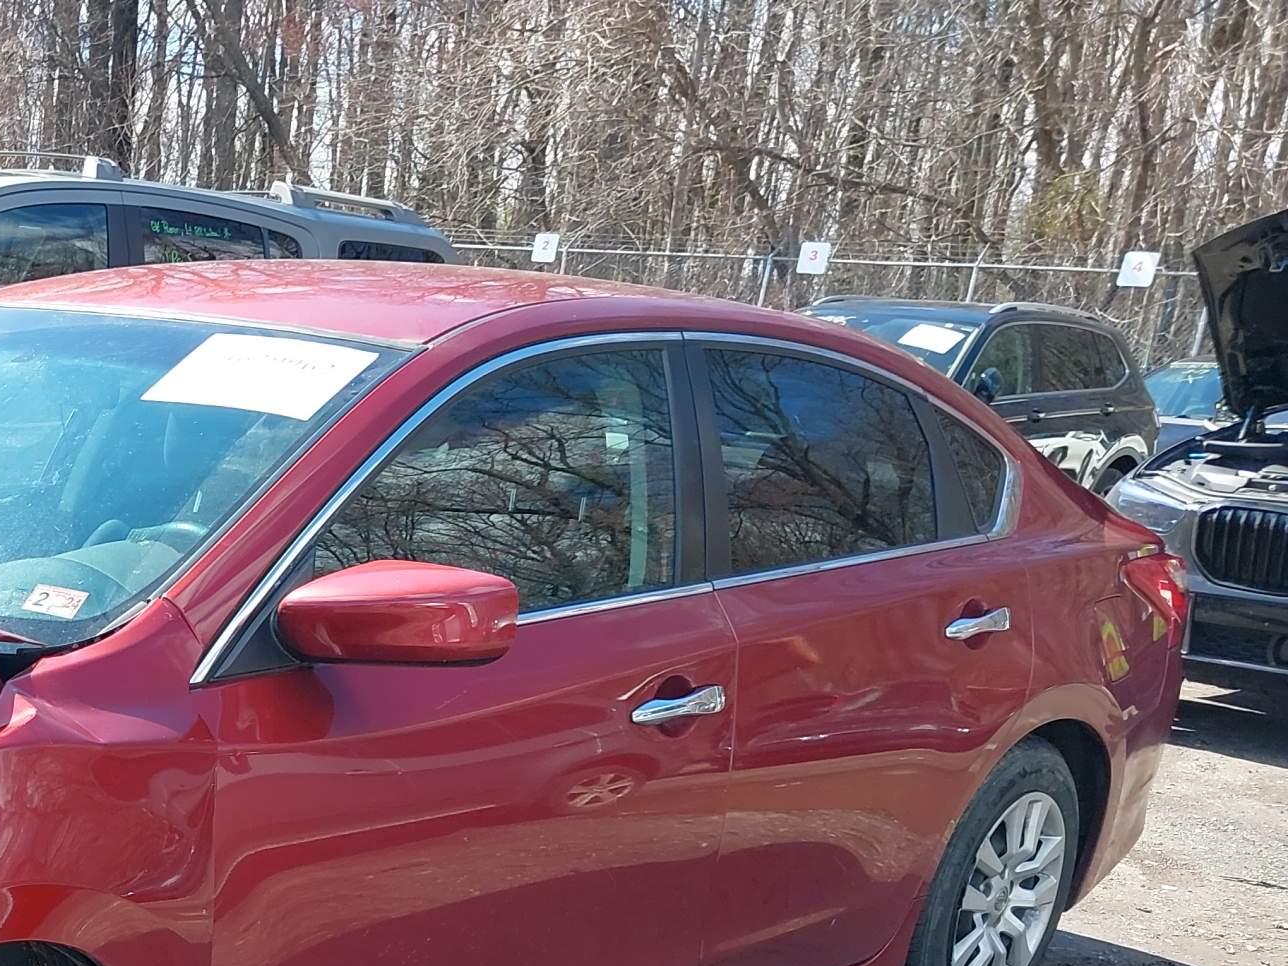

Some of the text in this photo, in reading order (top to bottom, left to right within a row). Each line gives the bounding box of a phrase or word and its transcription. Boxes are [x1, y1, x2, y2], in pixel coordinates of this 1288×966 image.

[541, 240, 550, 250] 2
[809, 250, 818, 261] 3
[1132, 260, 1144, 272] 4
[31, 591, 50, 607] 2
